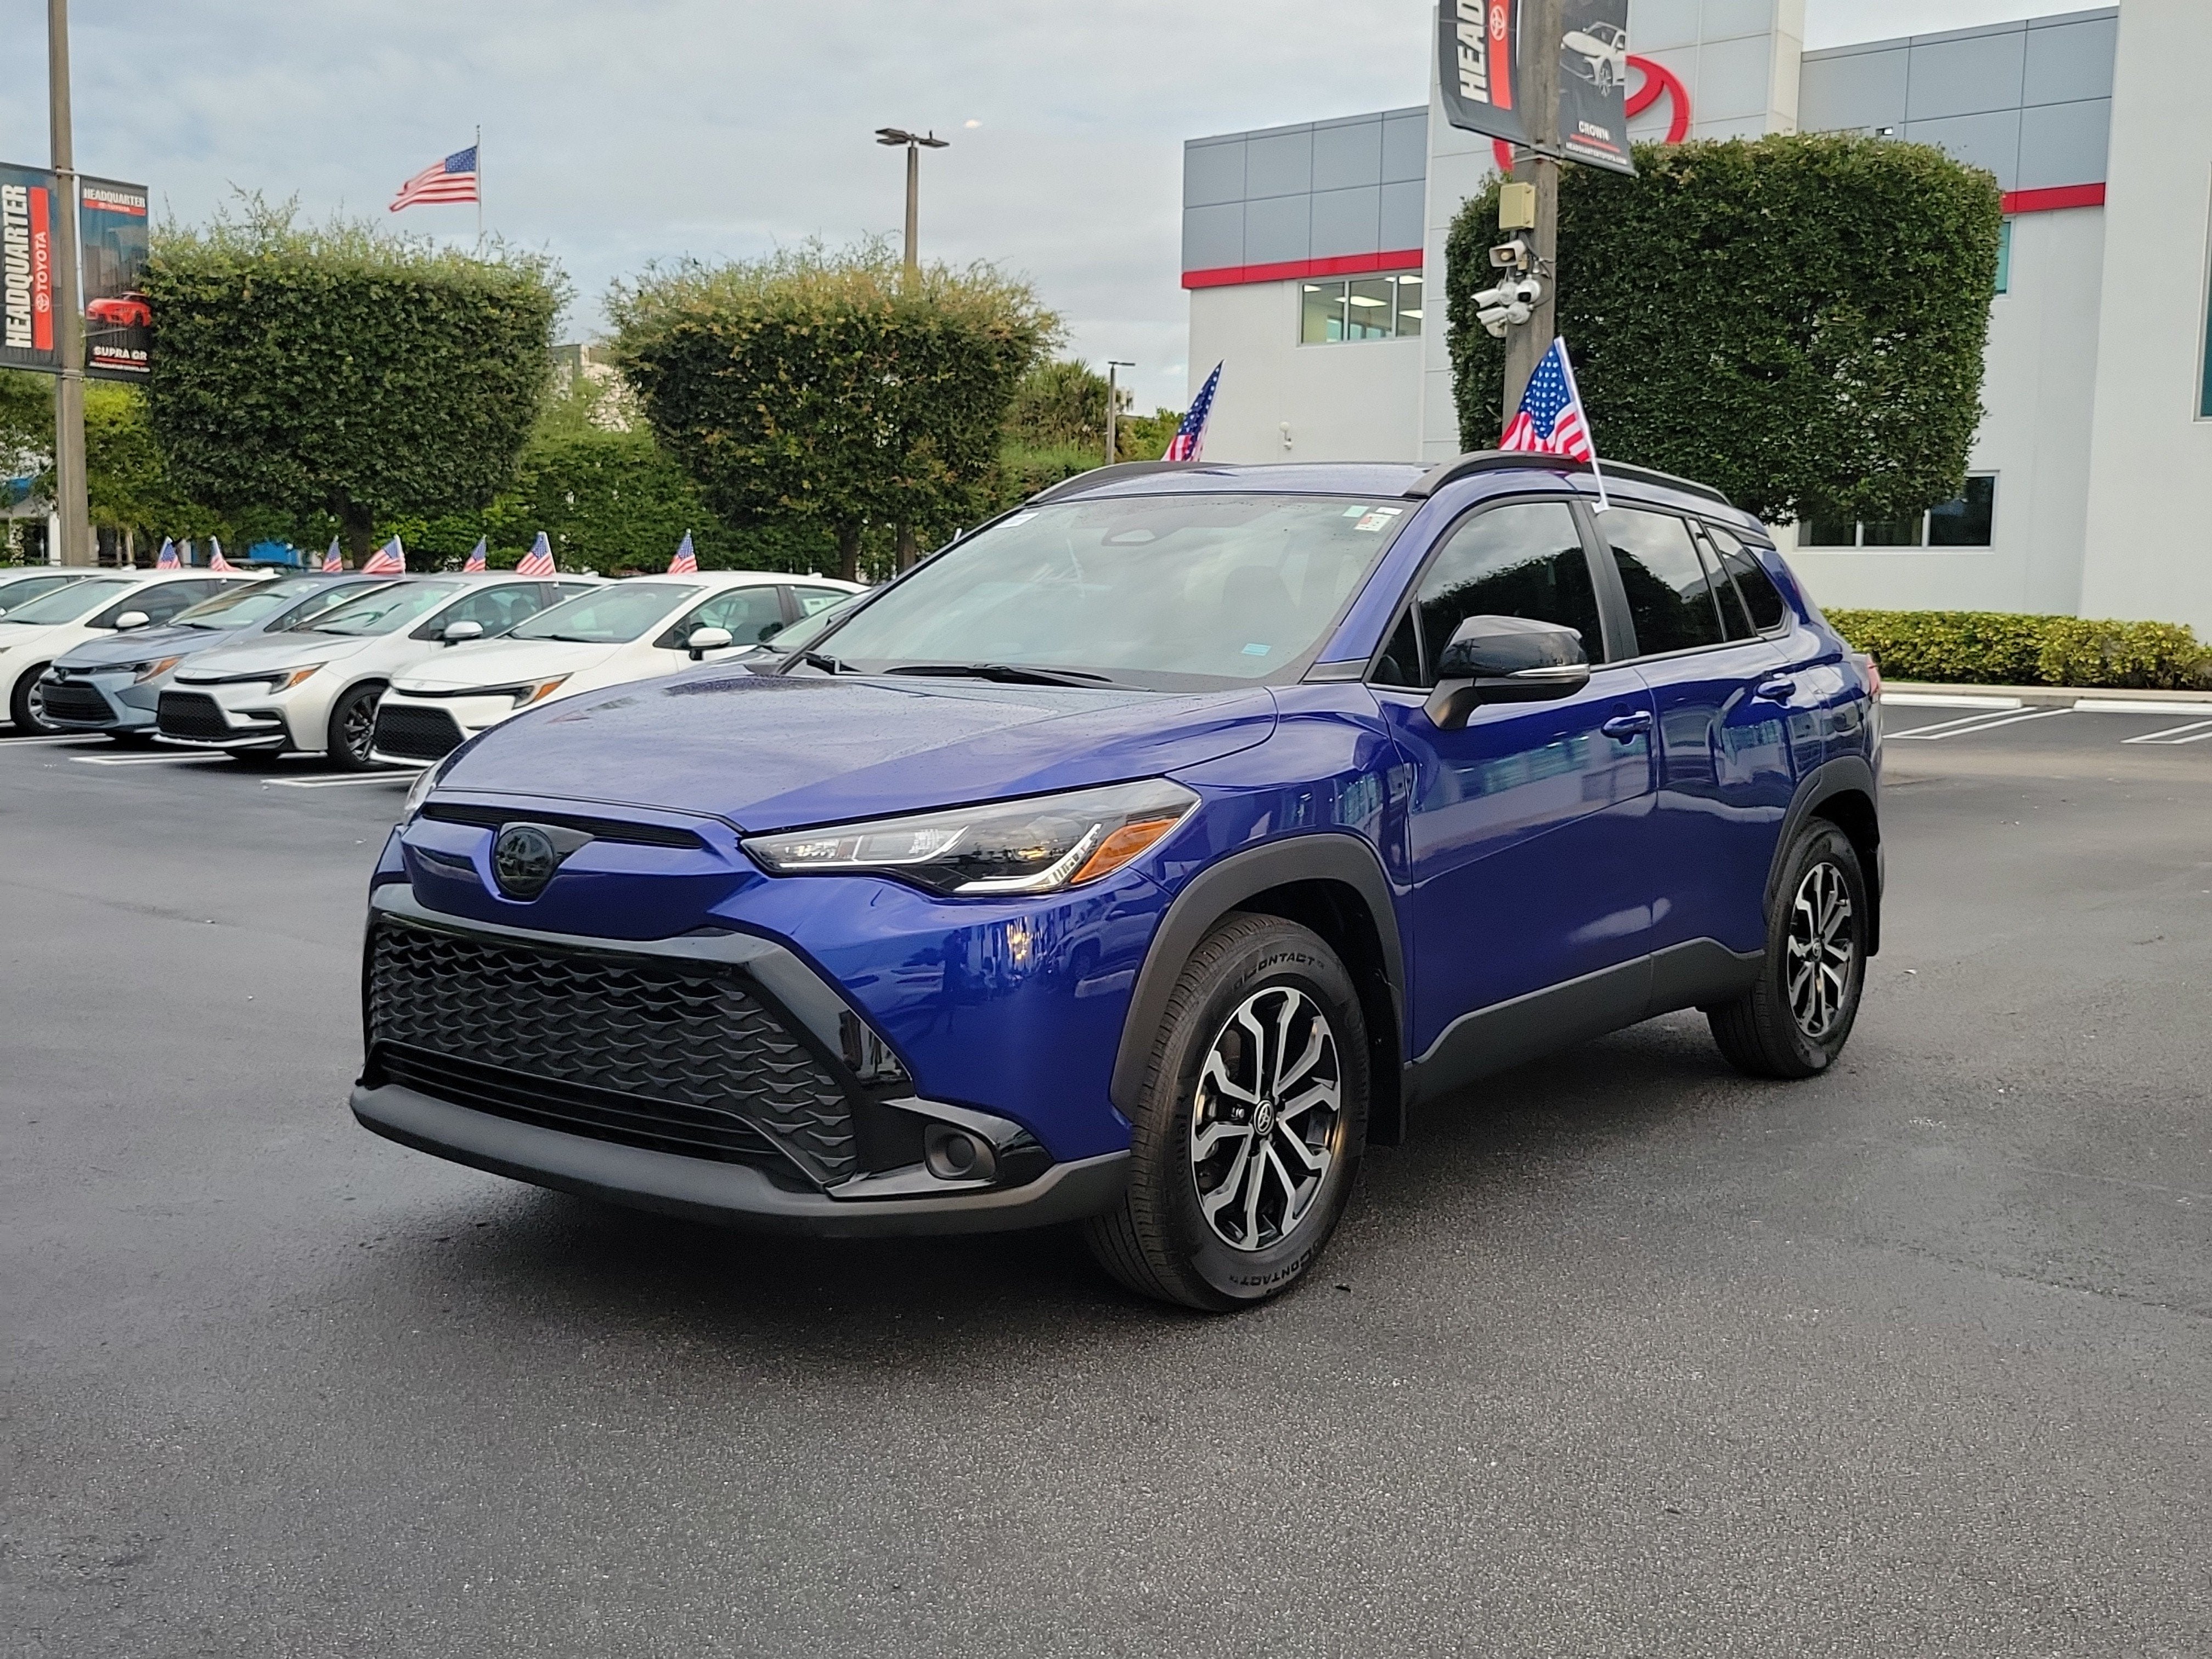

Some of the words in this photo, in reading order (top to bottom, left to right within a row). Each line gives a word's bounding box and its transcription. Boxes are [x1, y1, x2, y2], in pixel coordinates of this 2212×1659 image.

[1578, 120, 1610, 141] CROWN
[83, 188, 146, 208] HEADQUARTER
[2, 184, 33, 348] HEADQUARTER
[35, 231, 48, 292] TOYOTA
[93, 345, 131, 359] SUPRA
[131, 349, 148, 360] GR
